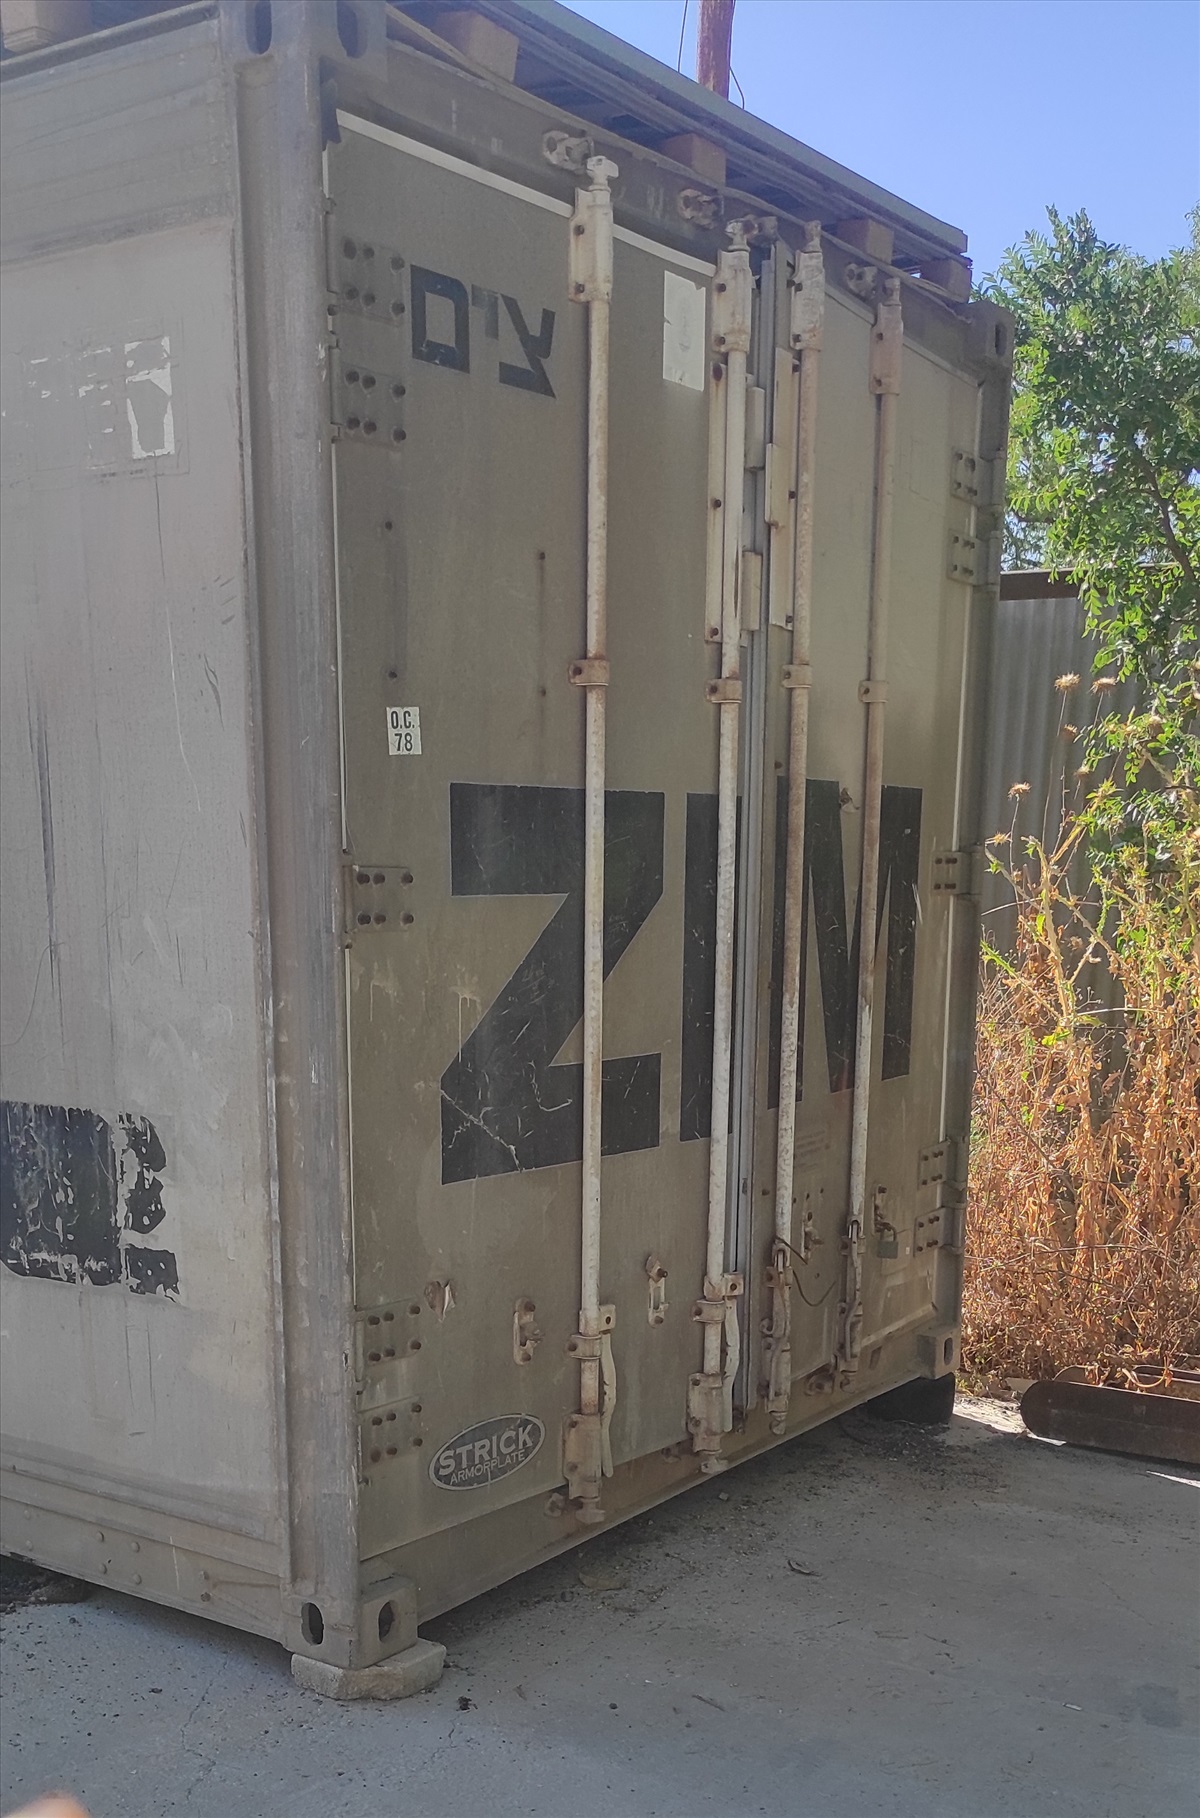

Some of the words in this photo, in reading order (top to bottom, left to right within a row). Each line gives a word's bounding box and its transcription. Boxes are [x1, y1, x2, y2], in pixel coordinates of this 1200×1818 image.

[390, 710, 415, 730] O.C.
[394, 732, 413, 752] 78
[440, 775, 923, 1185] ZIM
[438, 1423, 534, 1476] STRICK
[449, 1448, 526, 1485] ARMORPLATE
